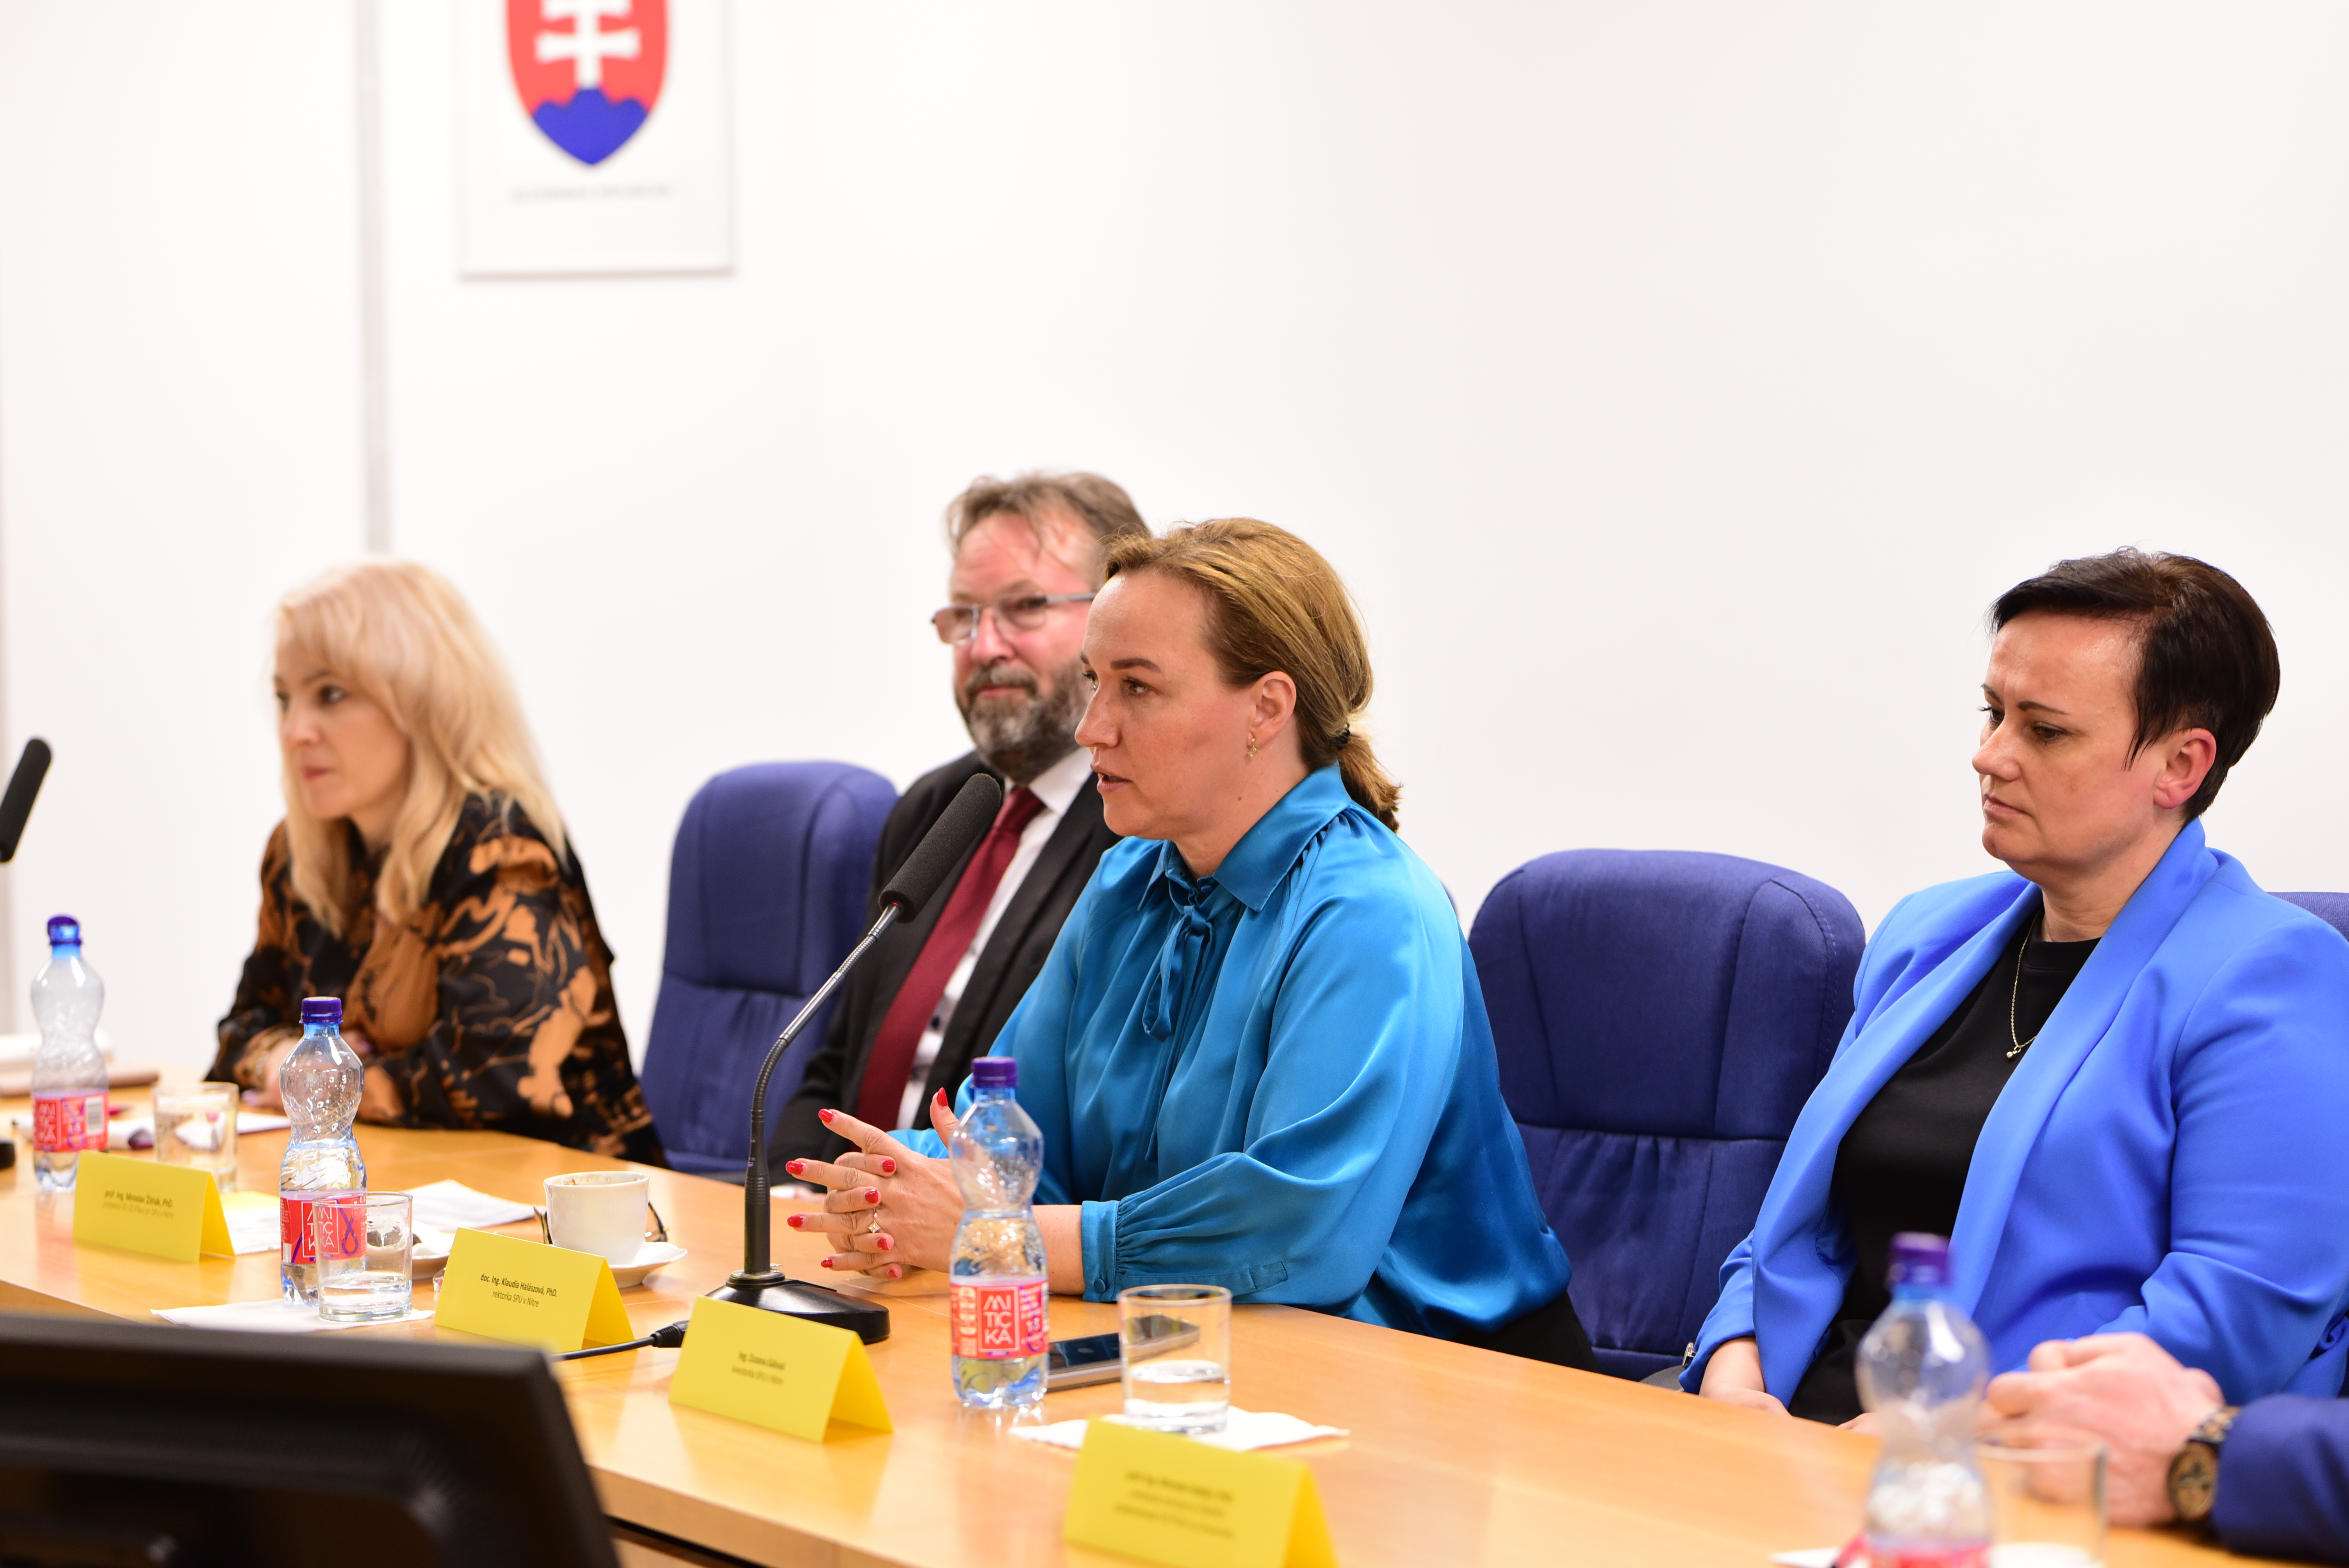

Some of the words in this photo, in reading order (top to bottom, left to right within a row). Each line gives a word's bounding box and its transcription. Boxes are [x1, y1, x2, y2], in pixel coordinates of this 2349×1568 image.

[480, 1273, 490, 1283] doc.
[491, 1275, 500, 1286] Ing.
[501, 1278, 520, 1288] Klaudia
[520, 1281, 545, 1296] Halászová,
[545, 1288, 557, 1297] PhD.
[492, 1290, 512, 1301] rektorka
[512, 1294, 523, 1303] SPU
[527, 1297, 539, 1308] Nitre
